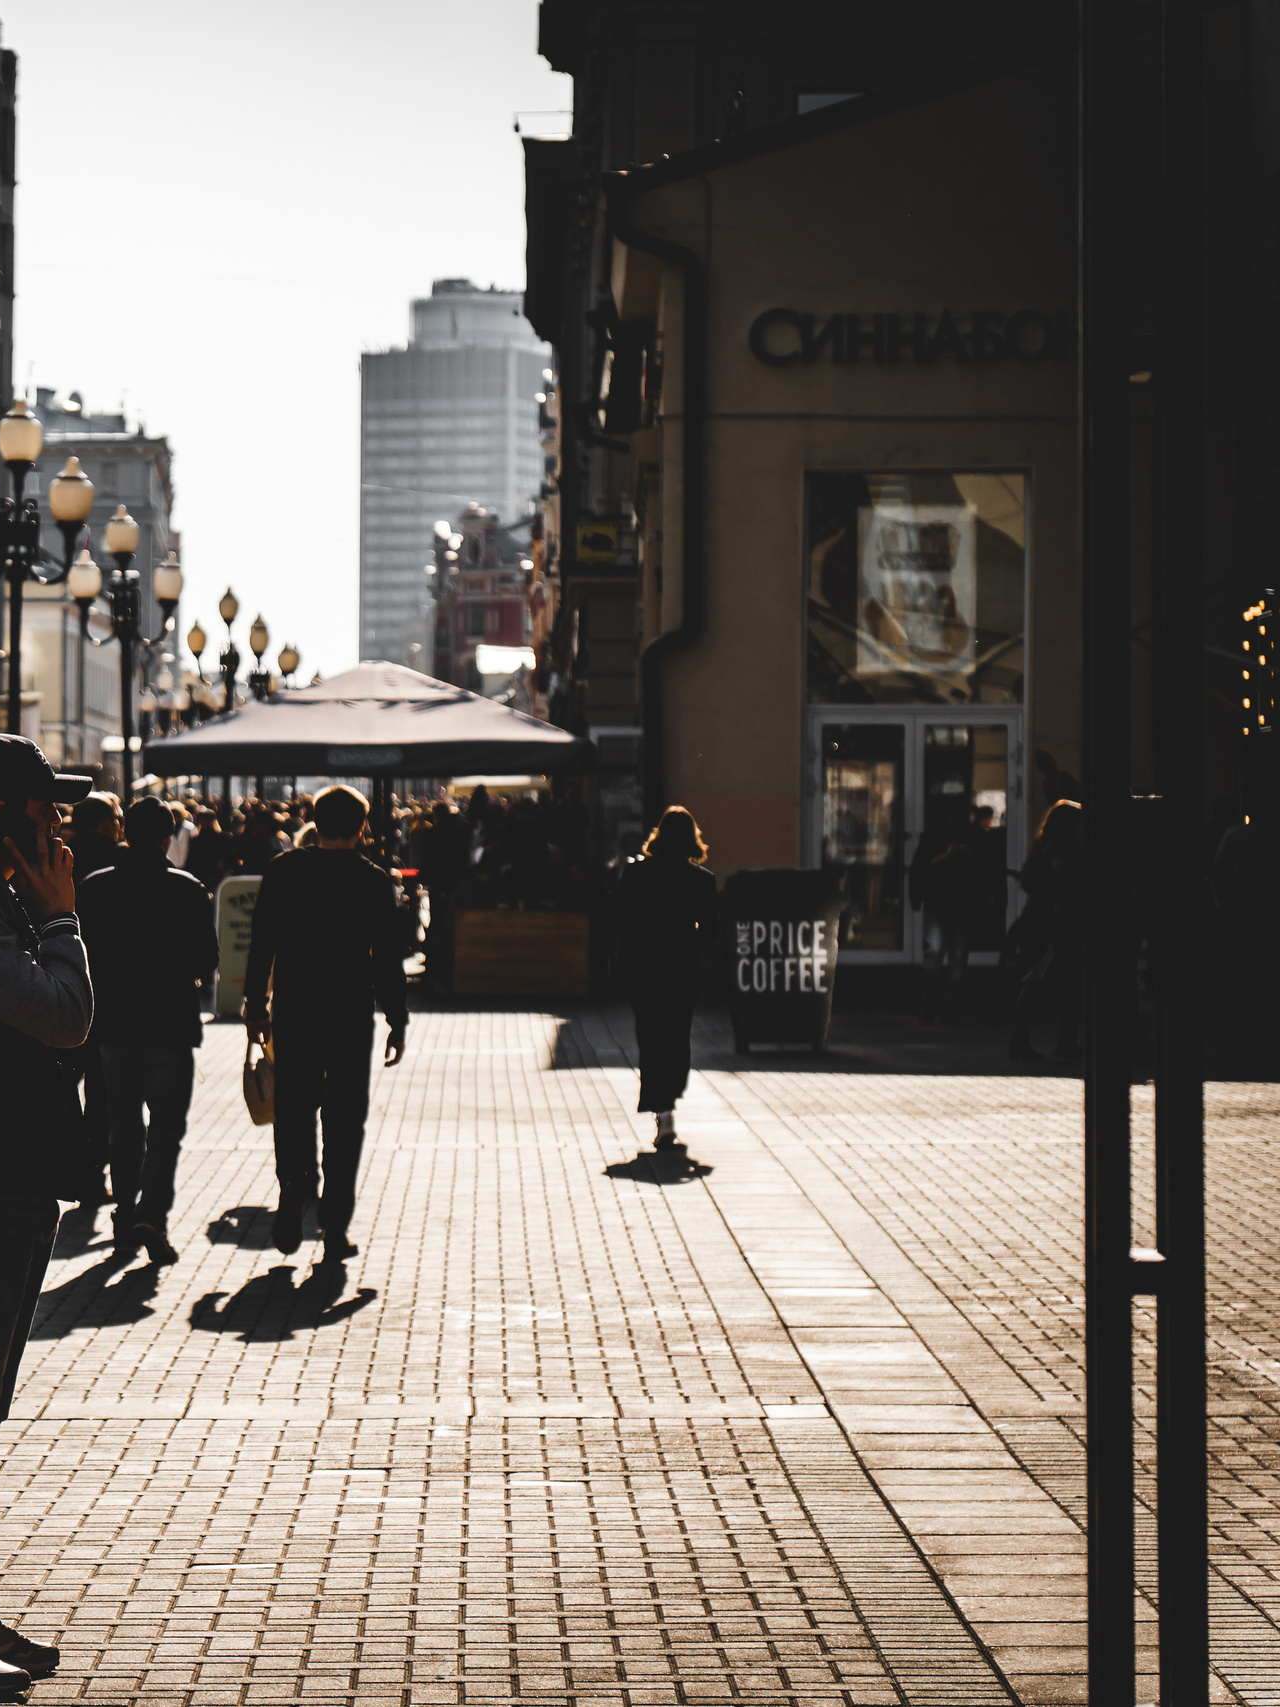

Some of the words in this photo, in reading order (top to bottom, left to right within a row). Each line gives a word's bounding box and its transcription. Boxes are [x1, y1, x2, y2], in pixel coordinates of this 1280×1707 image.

[736, 922, 751, 955] ONE
[753, 920, 827, 955] PRICE
[737, 957, 828, 992] COFFEE
